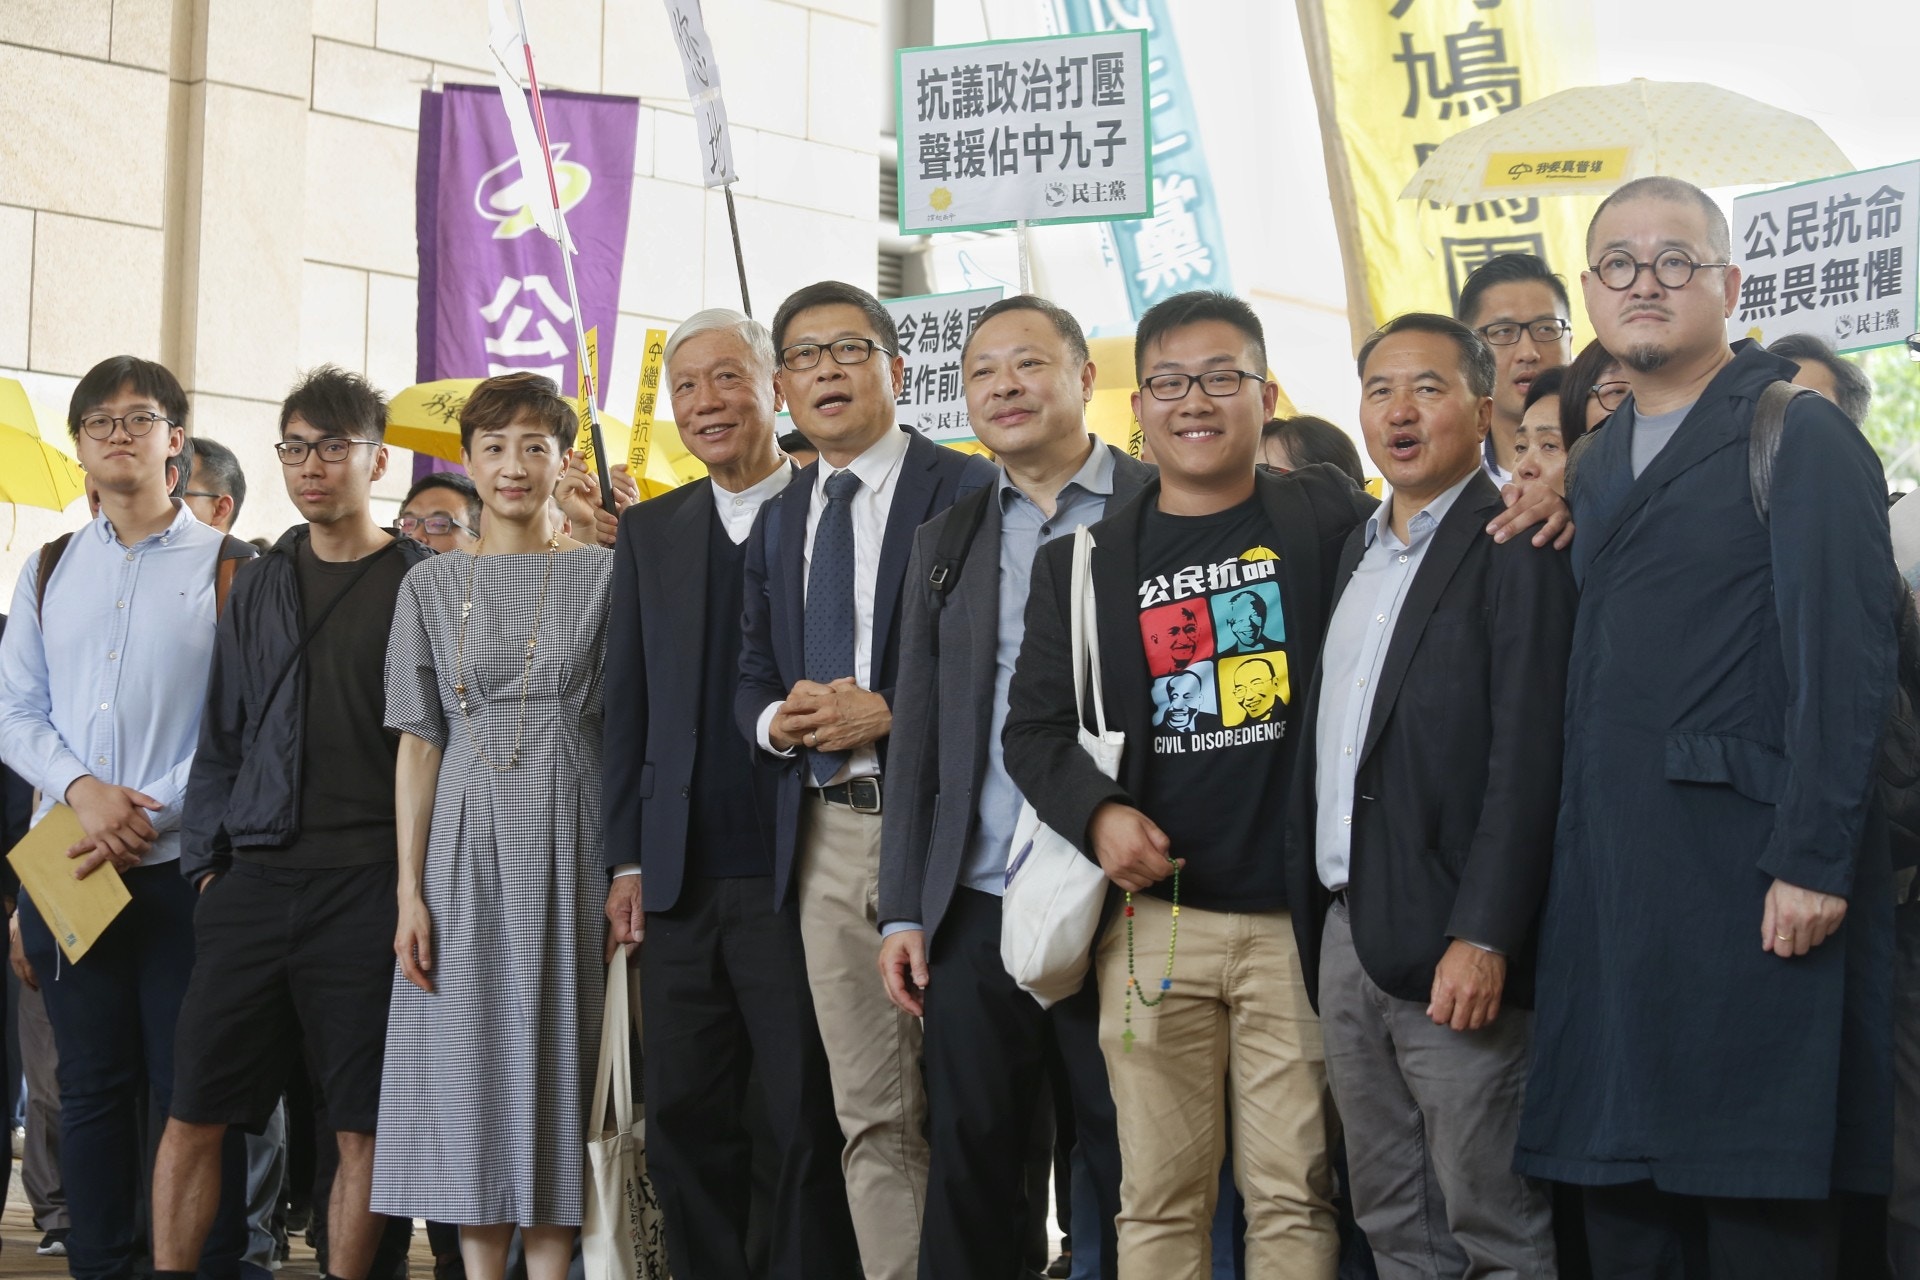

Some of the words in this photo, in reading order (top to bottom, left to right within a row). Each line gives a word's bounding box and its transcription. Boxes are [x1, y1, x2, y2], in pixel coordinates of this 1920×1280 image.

[917, 52, 1126, 122] 抗議政治打壓
[918, 119, 1127, 182] 聲援佔中九子
[1072, 181, 1127, 204] 民主黨
[1744, 184, 1905, 261] 公民抗命
[1739, 246, 1903, 322] 無畏無懼
[479, 275, 574, 385] 公
[1856, 308, 1900, 335] 民主黨
[937, 411, 971, 430] 民主
[1138, 546, 1280, 609] 公民抗命
[1154, 735, 1186, 754] CIVIL
[1191, 720, 1287, 752] DISOBEDIENCE
